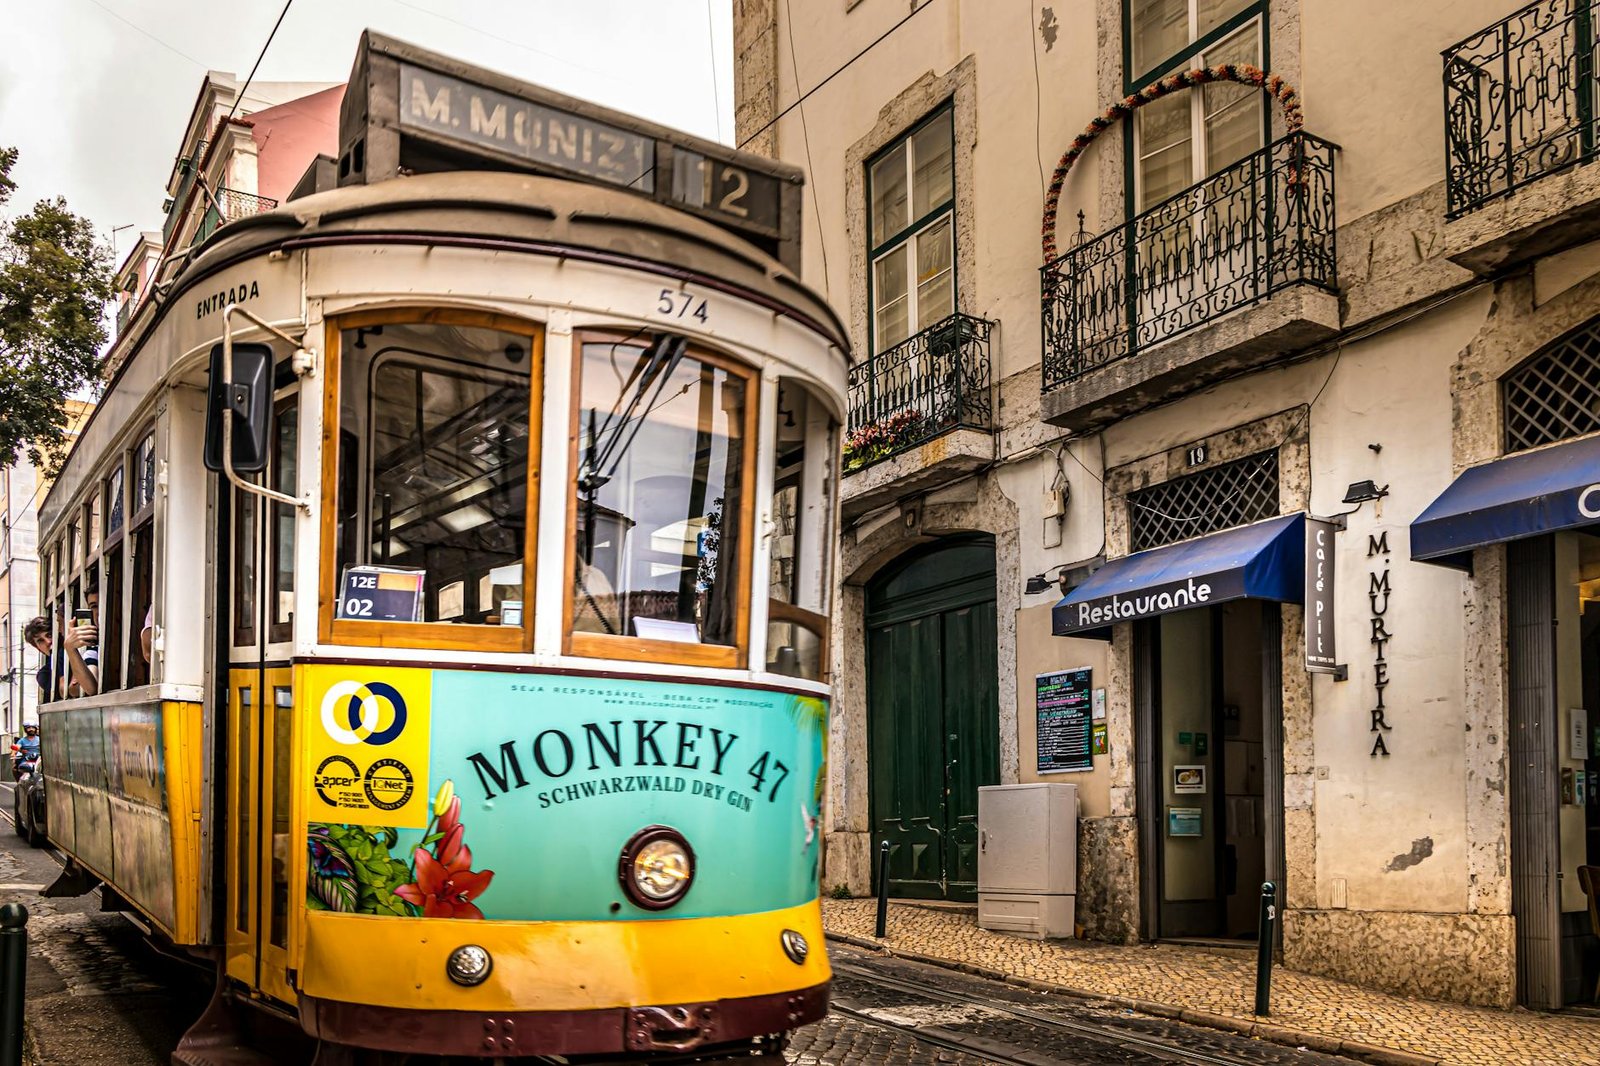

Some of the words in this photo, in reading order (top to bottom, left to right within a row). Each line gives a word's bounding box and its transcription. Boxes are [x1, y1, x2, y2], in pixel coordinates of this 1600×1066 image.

[410, 77, 461, 128] M.
[469, 95, 626, 173] MONIZ
[196, 280, 260, 320] ENTRADA
[657, 289, 710, 324] 574
[1189, 446, 1205, 467] 19
[1315, 529, 1326, 593] Café
[350, 576, 377, 590] 12E
[345, 598, 374, 617] 02
[1078, 578, 1212, 627] Restaurante
[511, 684, 545, 693] SEJA
[465, 719, 740, 801] MONKEY
[747, 750, 790, 803] 47
[322, 775, 354, 789] apcer
[537, 775, 687, 809] SCHWARZWALD
[691, 778, 726, 801] DRY
[726, 789, 754, 813] GIN
